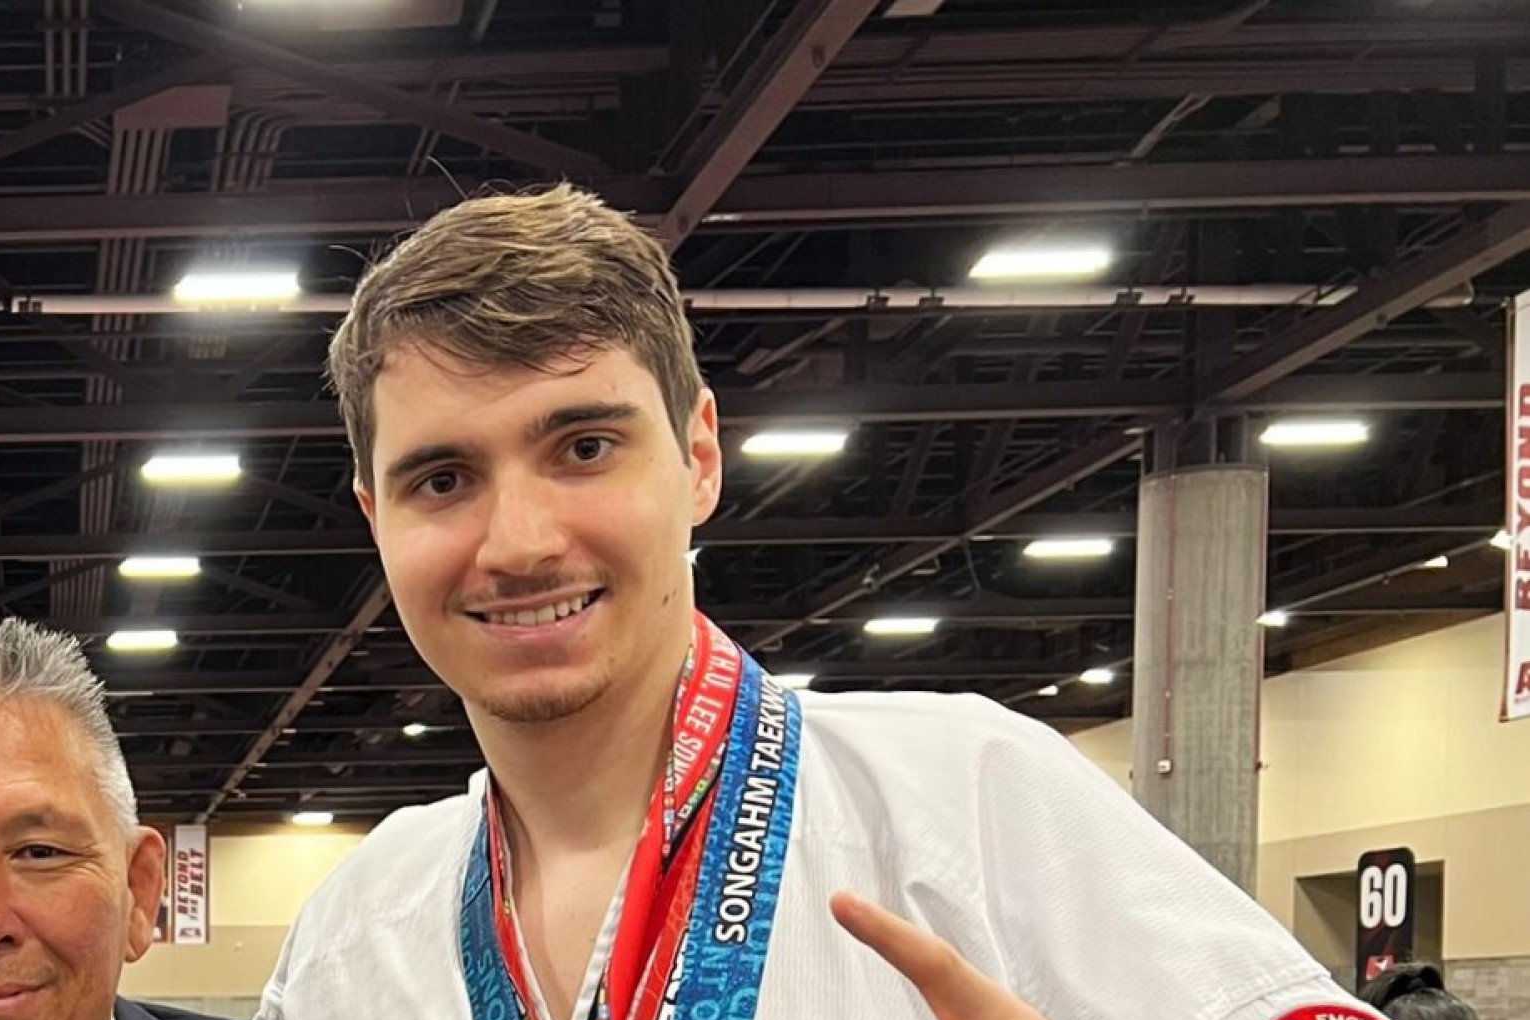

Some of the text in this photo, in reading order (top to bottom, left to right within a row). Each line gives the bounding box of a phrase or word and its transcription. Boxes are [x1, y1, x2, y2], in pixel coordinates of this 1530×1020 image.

[684, 696, 723, 735] LEE
[178, 850, 189, 916] BEYOND
[190, 847, 205, 898] BELT
[716, 776, 777, 942] SONGAHM
[1359, 862, 1408, 930] 60
